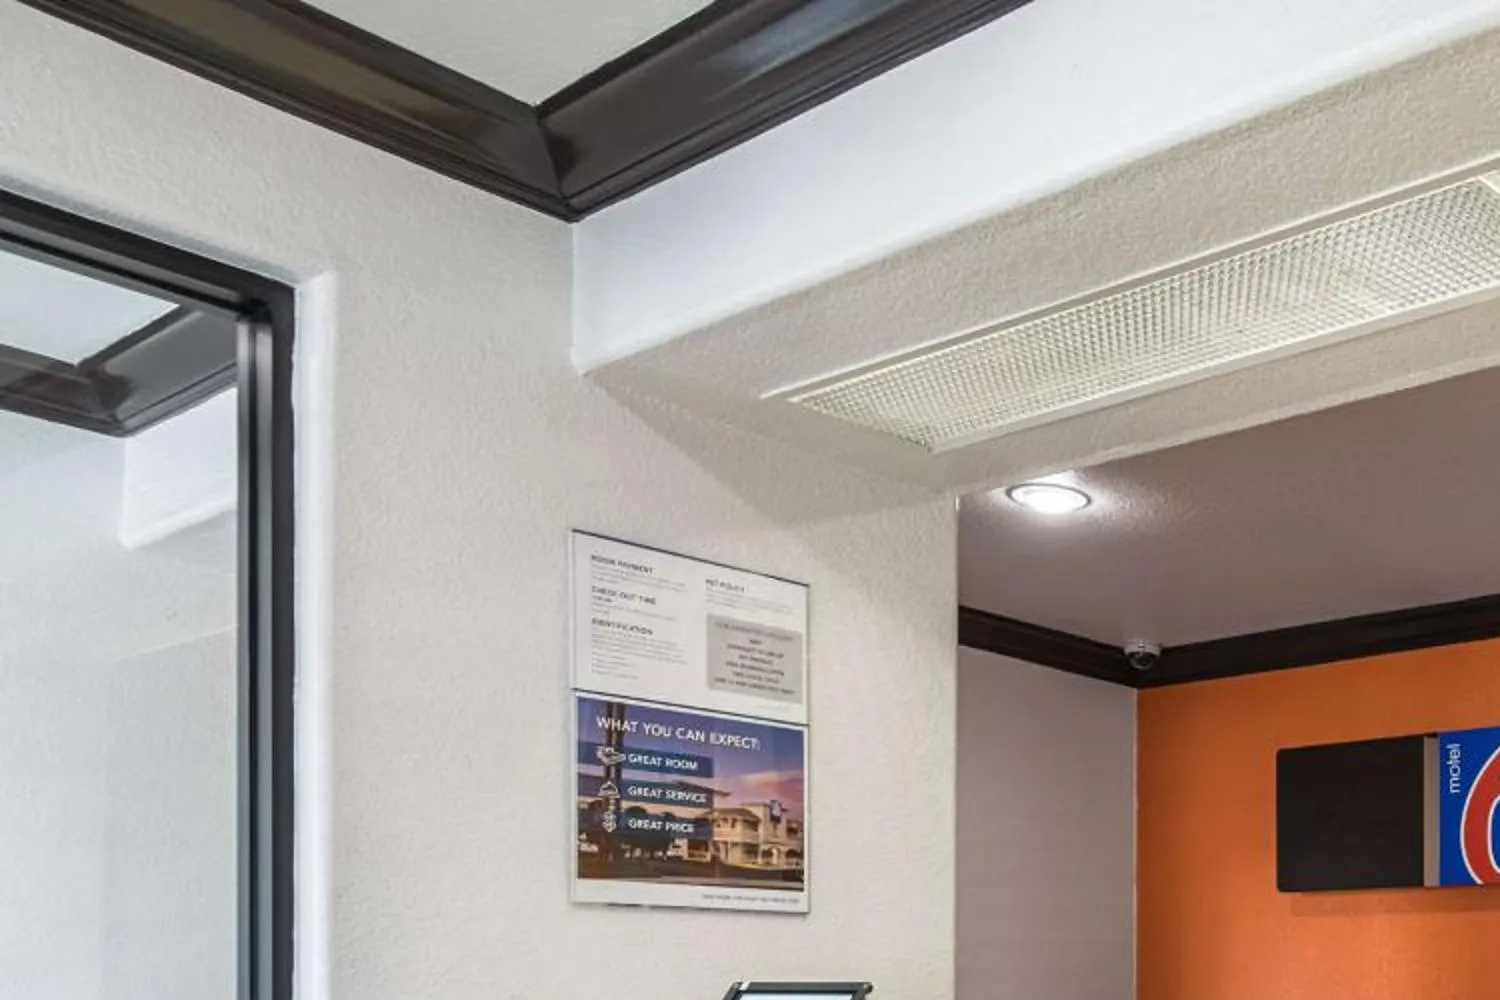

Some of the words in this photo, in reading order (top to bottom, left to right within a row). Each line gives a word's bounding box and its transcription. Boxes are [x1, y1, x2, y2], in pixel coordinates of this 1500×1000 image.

[596, 715, 639, 732] WHAT
[643, 723, 672, 738] YOU
[676, 728, 705, 742] CAN
[709, 732, 761, 750] EXPECT:
[628, 753, 662, 767] GREAT
[666, 758, 698, 771] ROOM
[1447, 743, 1460, 794] motel
[627, 786, 662, 798] GREAT
[666, 790, 707, 803] SERVICE
[628, 818, 662, 831] GREAT
[666, 821, 694, 833] PRICE
